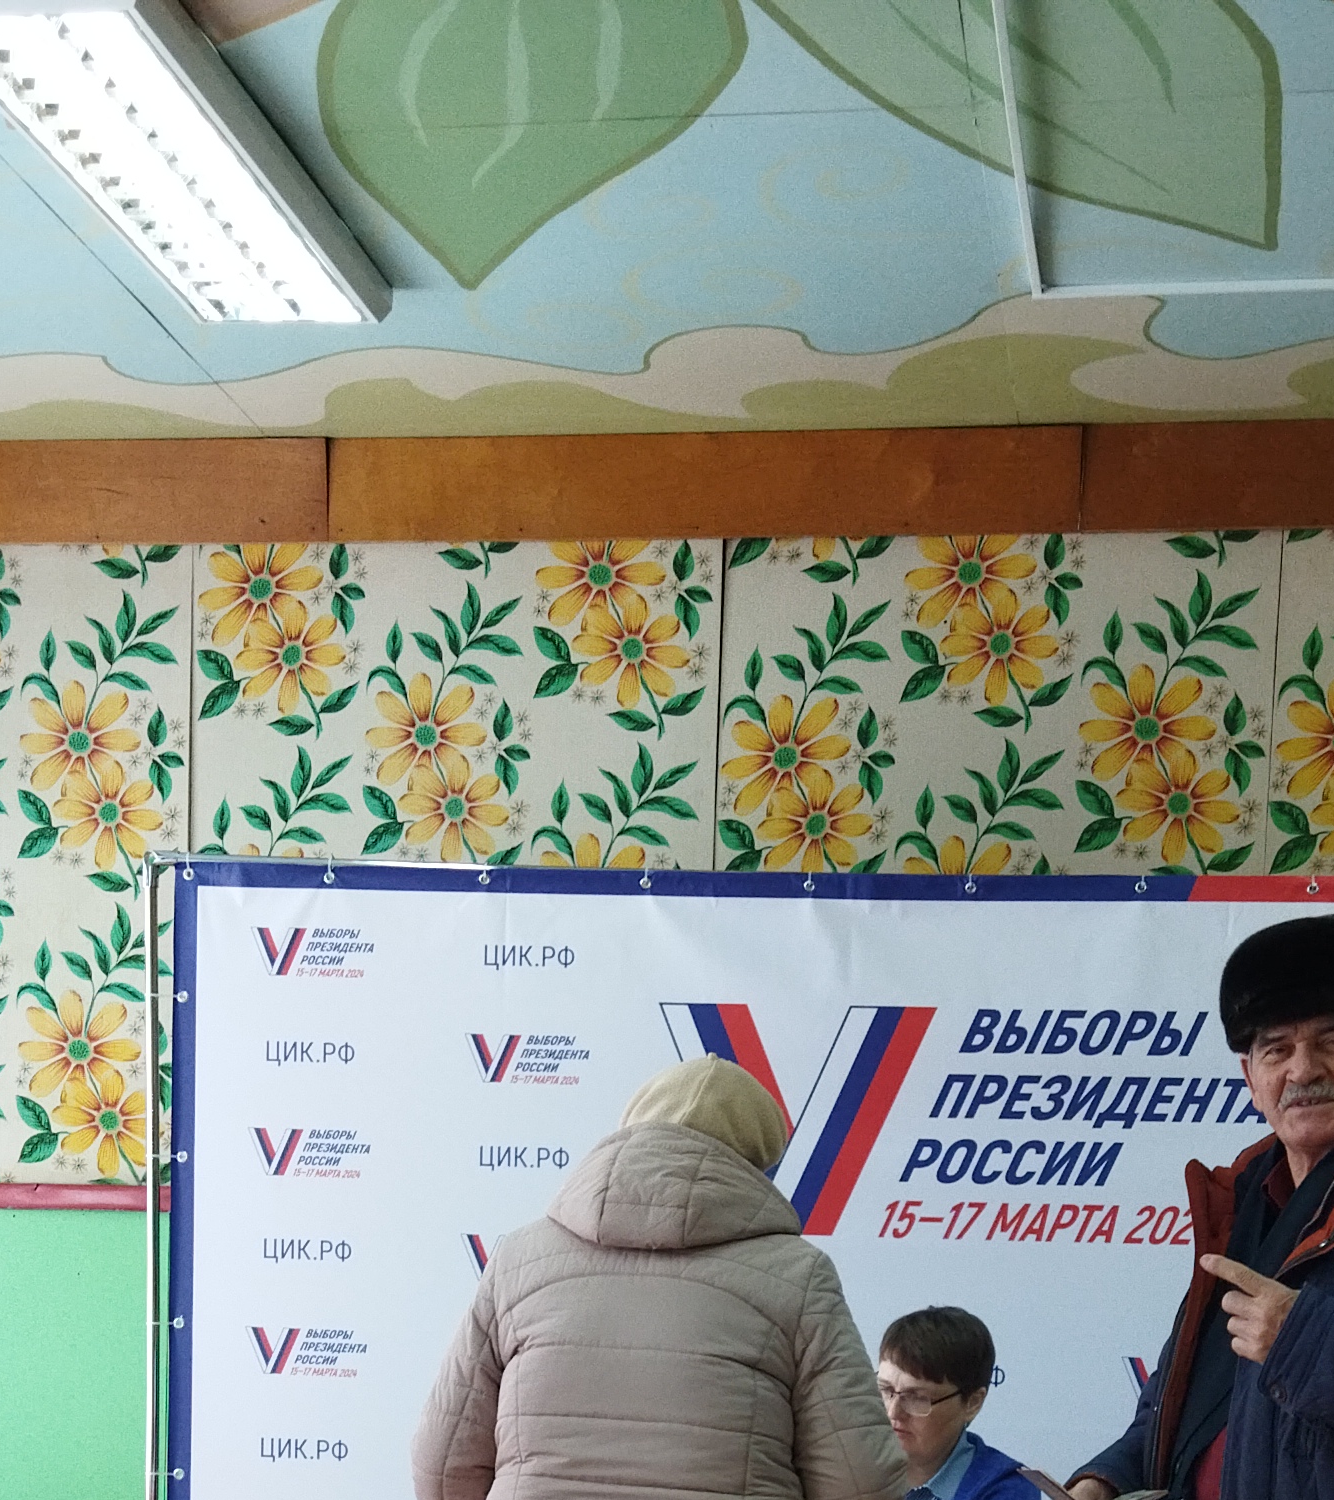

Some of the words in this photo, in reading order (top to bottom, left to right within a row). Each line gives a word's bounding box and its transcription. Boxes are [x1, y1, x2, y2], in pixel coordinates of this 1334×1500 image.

[312, 928, 361, 940] ВЫБОРЫ
[306, 942, 375, 954] ПРЕЗИДЕНТА
[300, 955, 344, 966] РОССИИ
[484, 945, 574, 970] ЦИК.РФ
[318, 968, 345, 978] МАРТА
[345, 969, 365, 978] 2024
[959, 1009, 1209, 1056] ВЫБОРЫ
[526, 1035, 576, 1046] ВЫБОРЫ
[266, 1041, 355, 1066] ЦИК.РФ
[520, 1049, 590, 1061] ПРЕЗИДЕНТА
[514, 1062, 559, 1073] РОССИИ
[533, 1075, 560, 1085] МАРТА
[560, 1076, 580, 1085] 2024
[929, 1073, 1267, 1130] ПРЕЗИДЕНТА
[308, 1129, 357, 1141] ВЫБОРЫ
[302, 1142, 371, 1155] ПРЕЗИДЕНТА
[297, 1155, 341, 1167] РОССИИ
[478, 1145, 570, 1172] ЦИК.РФ
[899, 1139, 1124, 1186] РОССИИ
[315, 1169, 342, 1178] МАРТА
[342, 1170, 361, 1179] 2024
[879, 1200, 987, 1239] 15–17
[986, 1203, 1119, 1243] МАРТА
[1122, 1205, 1192, 1246] 202
[264, 1238, 351, 1263] ЦИК.РФ
[305, 1328, 354, 1340] ВЫБОРЫ
[300, 1342, 368, 1354] ПРЕЗИДЕНТА
[294, 1354, 338, 1366] РОССИИ
[312, 1367, 339, 1377] МАРТА
[338, 1369, 358, 1378] 2024
[261, 1438, 348, 1462] ЦИК.РФ
